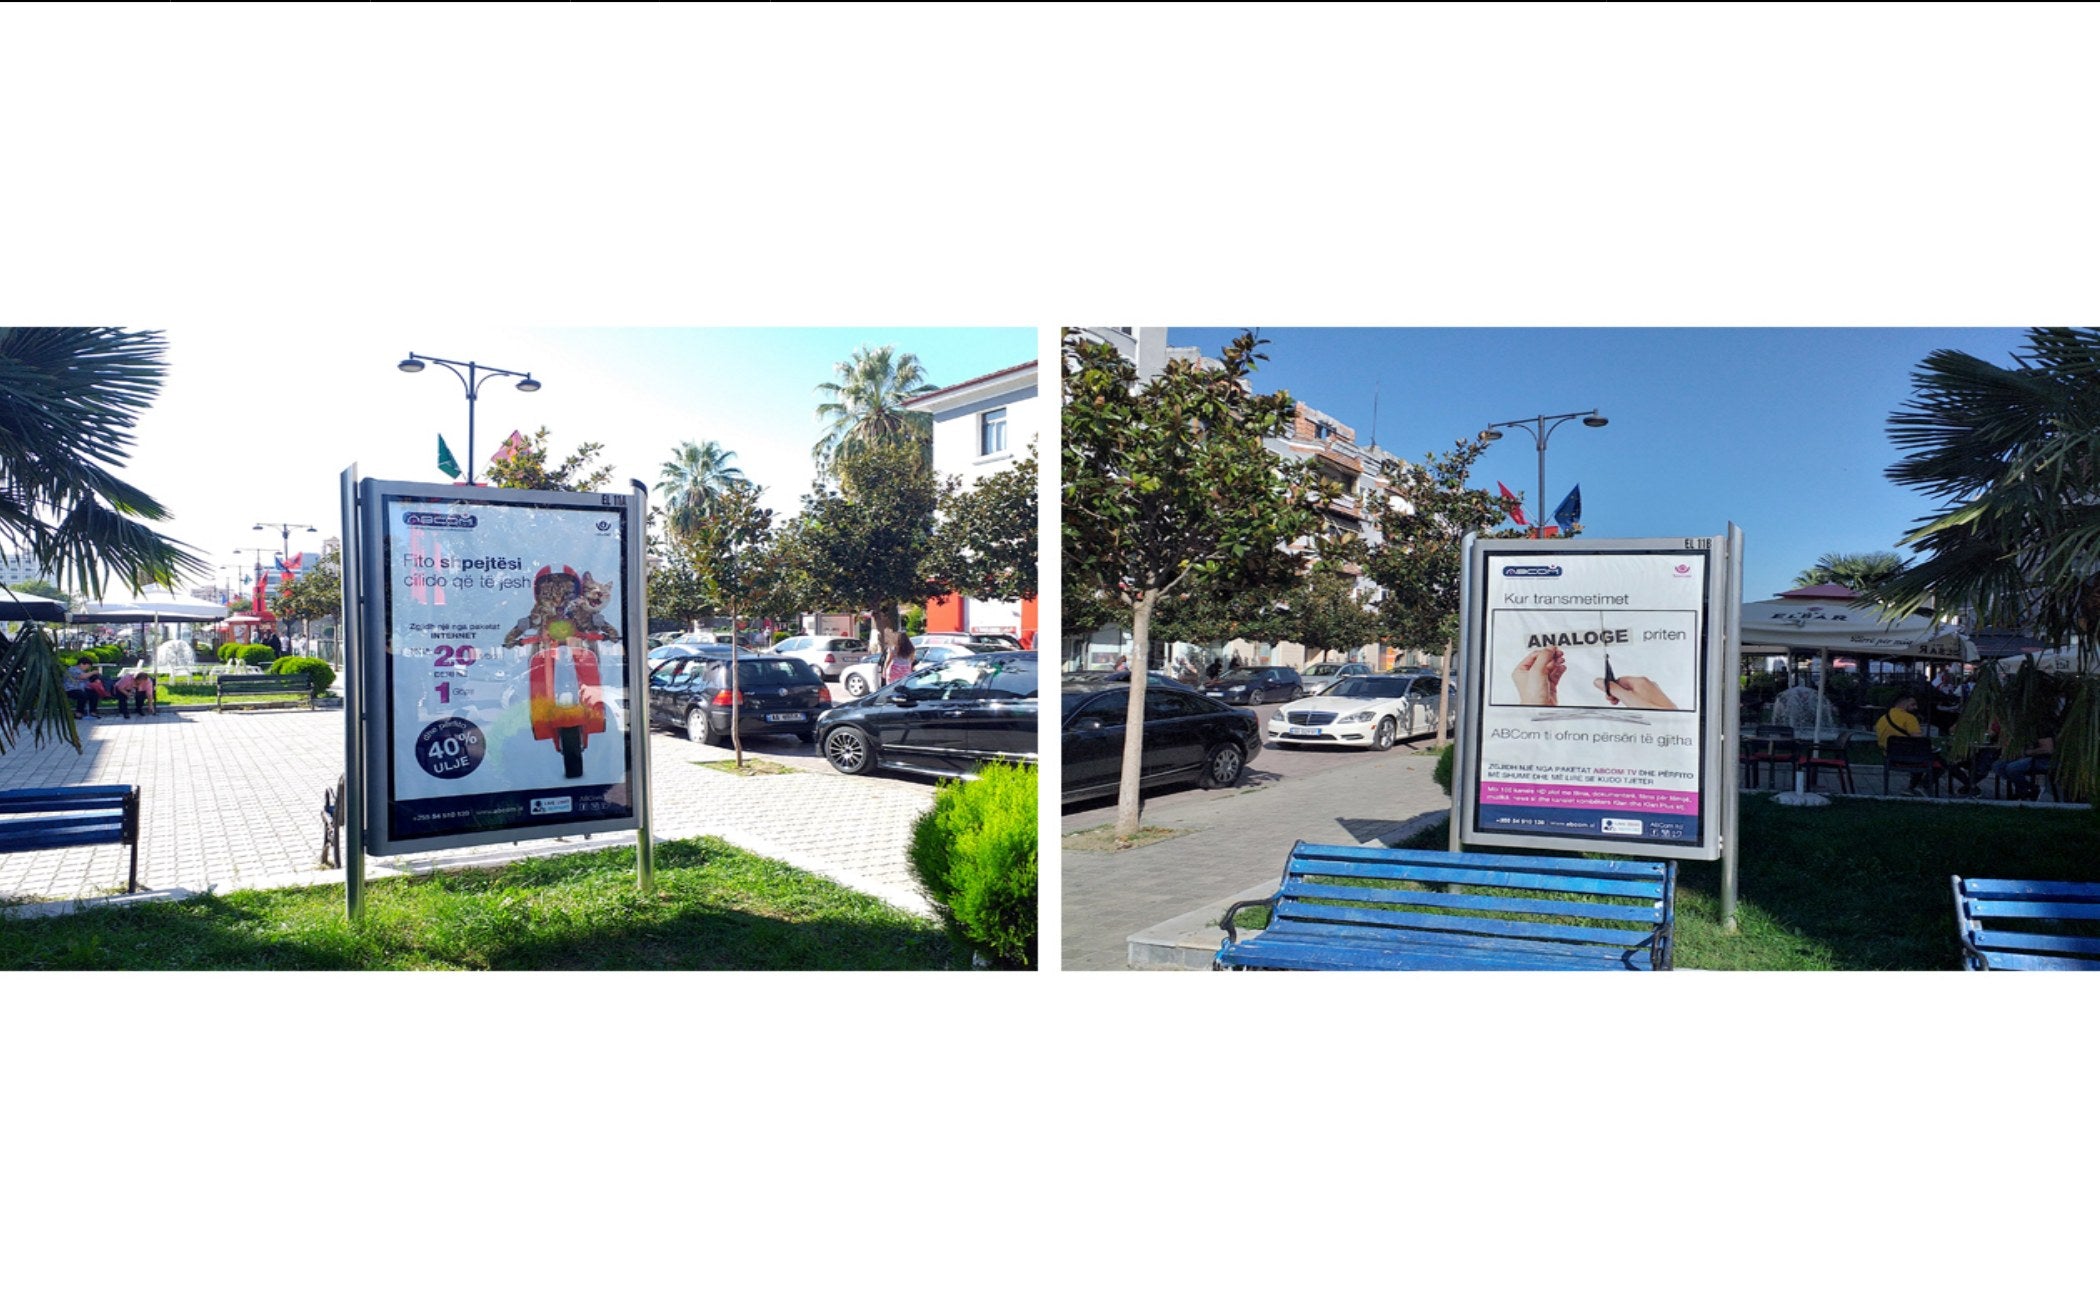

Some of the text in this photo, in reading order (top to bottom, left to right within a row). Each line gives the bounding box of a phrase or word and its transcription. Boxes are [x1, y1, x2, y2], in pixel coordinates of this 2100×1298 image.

[1684, 538, 1712, 549] EL 11B
[403, 553, 522, 572] Fito shpejtësi
[403, 573, 531, 591] cilido që të jesh
[1504, 593, 1629, 605] Kur transmetimet
[1771, 612, 1847, 621] ELBAR
[430, 632, 476, 640] INTERNET
[1527, 629, 1629, 648] ANALOGE
[1643, 628, 1687, 642] priten
[433, 644, 477, 667] 20
[434, 681, 450, 704] 1
[1491, 728, 1693, 747] ABCom ti ofron përsëri të gjitha
[433, 755, 470, 773] ULJE
[1593, 767, 1624, 776] ABCOM
[1627, 768, 1637, 776] TV
[1598, 776, 1621, 784] KUDO
